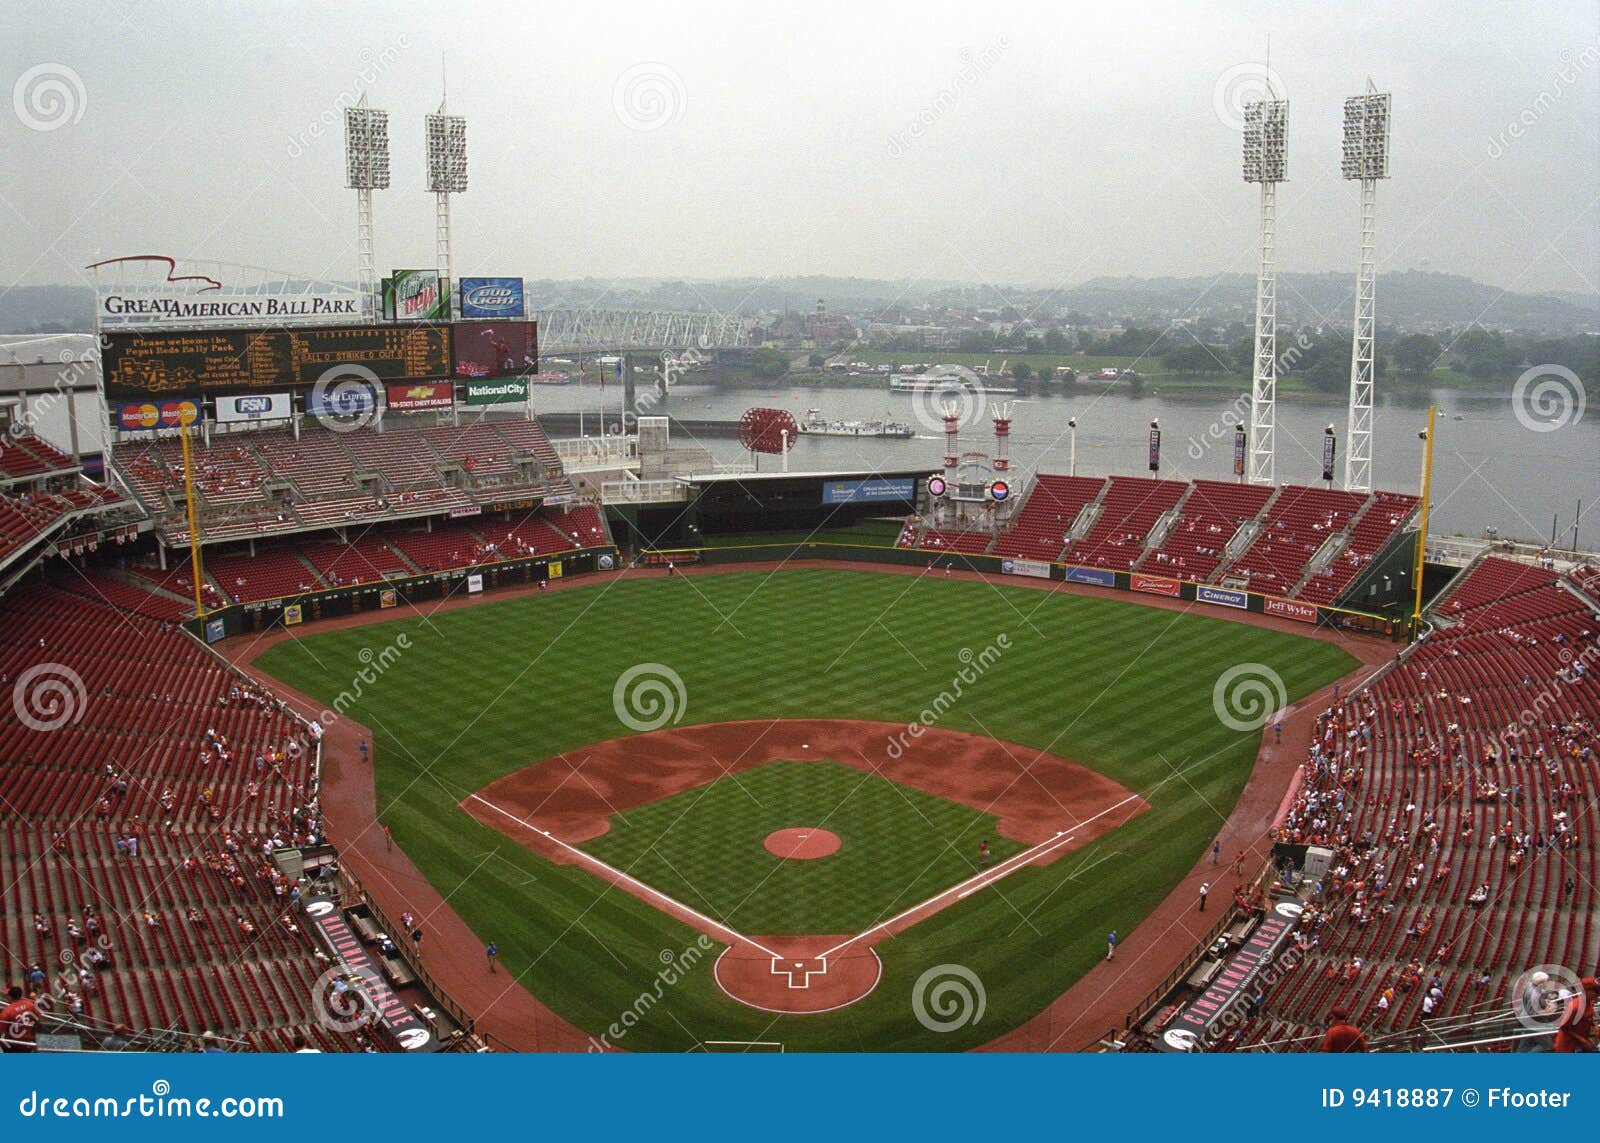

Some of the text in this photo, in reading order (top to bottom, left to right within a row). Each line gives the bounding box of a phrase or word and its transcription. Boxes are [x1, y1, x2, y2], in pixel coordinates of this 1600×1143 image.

[479, 289, 512, 297] BUD
[105, 296, 357, 317] GREAT AMERICAN BALL PARK
[473, 297, 517, 305] LIGHT
[469, 384, 525, 396] National City
[240, 398, 267, 412] FSN
[1266, 600, 1285, 611] Jeff
[321, 915, 414, 1027] NATIONAL LEAGUE
[1183, 950, 1262, 1025] CINCINNATI
[1251, 918, 1286, 948] REDS
